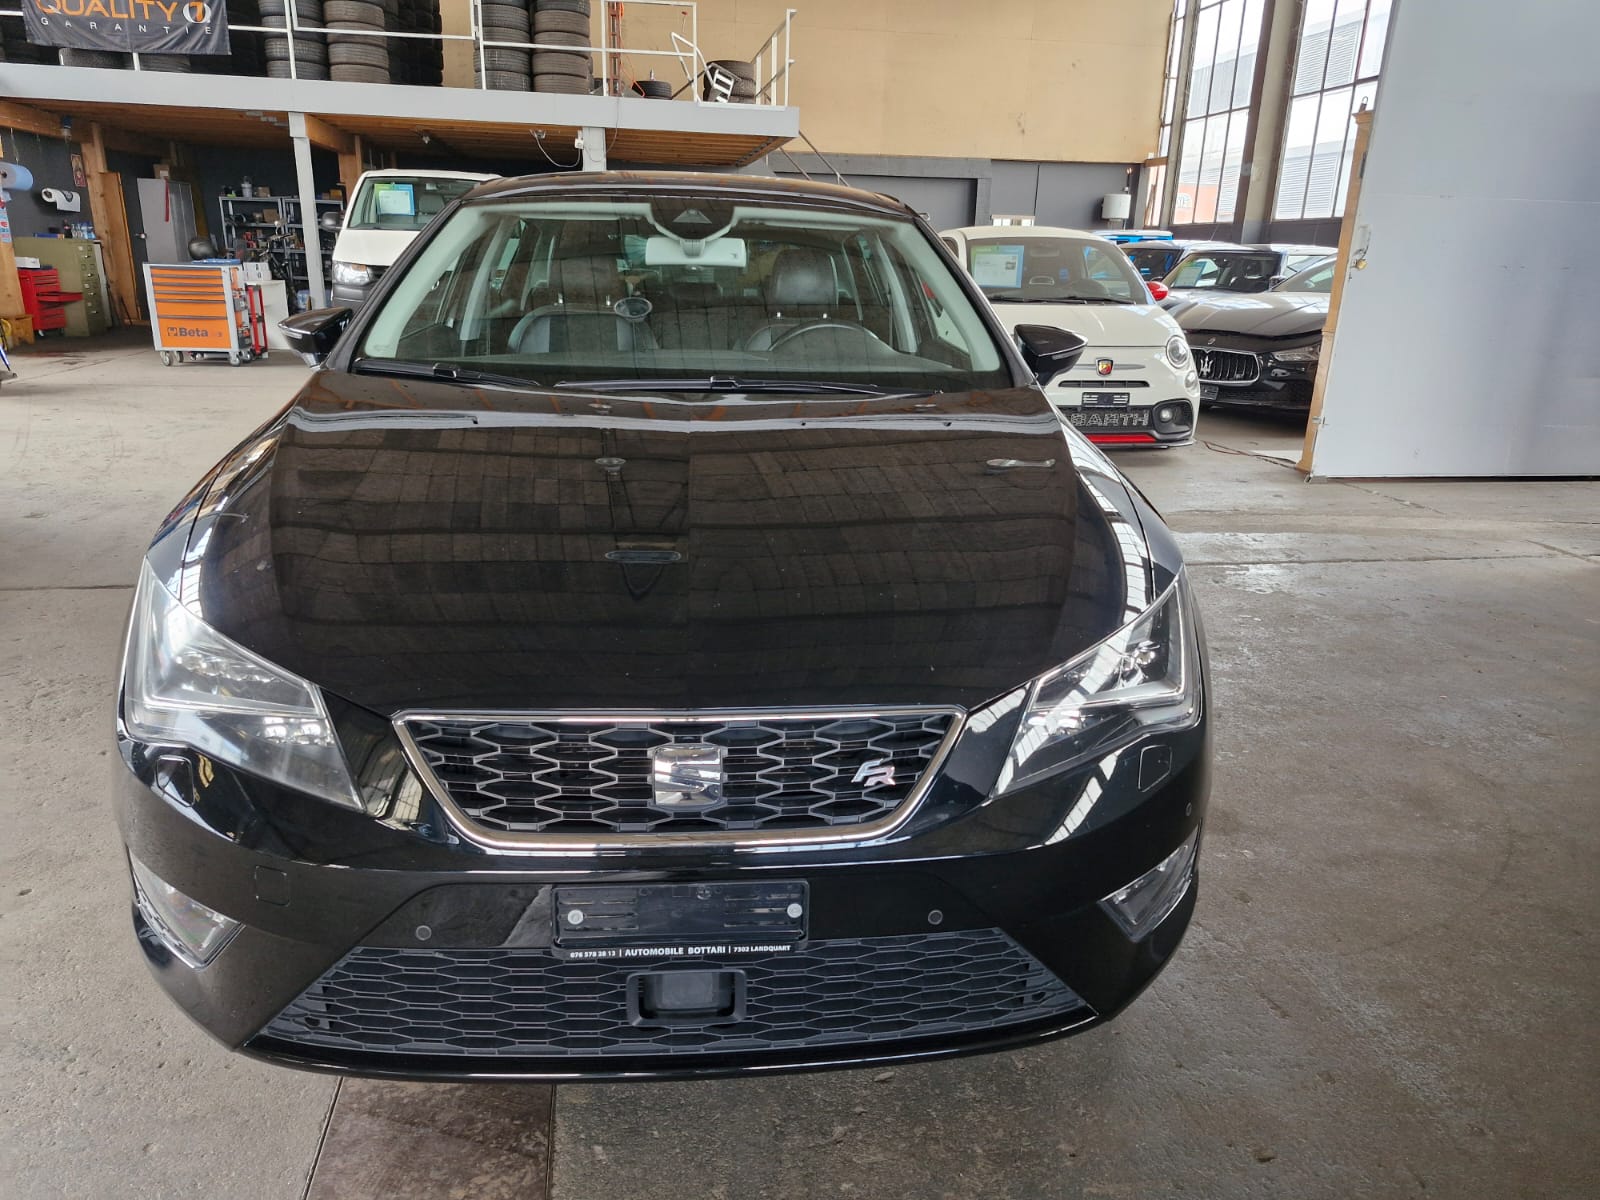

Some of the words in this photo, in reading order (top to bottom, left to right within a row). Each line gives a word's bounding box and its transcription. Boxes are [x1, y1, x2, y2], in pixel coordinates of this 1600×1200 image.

[36, 0, 178, 22] QUALITY
[40, 17, 212, 35] GARANTIE
[178, 327, 209, 337] Beta
[1064, 411, 1150, 427] BARTH
[851, 758, 896, 787] FR
[625, 947, 684, 956] AUTOMOBILE
[688, 945, 726, 954] BOTTARI
